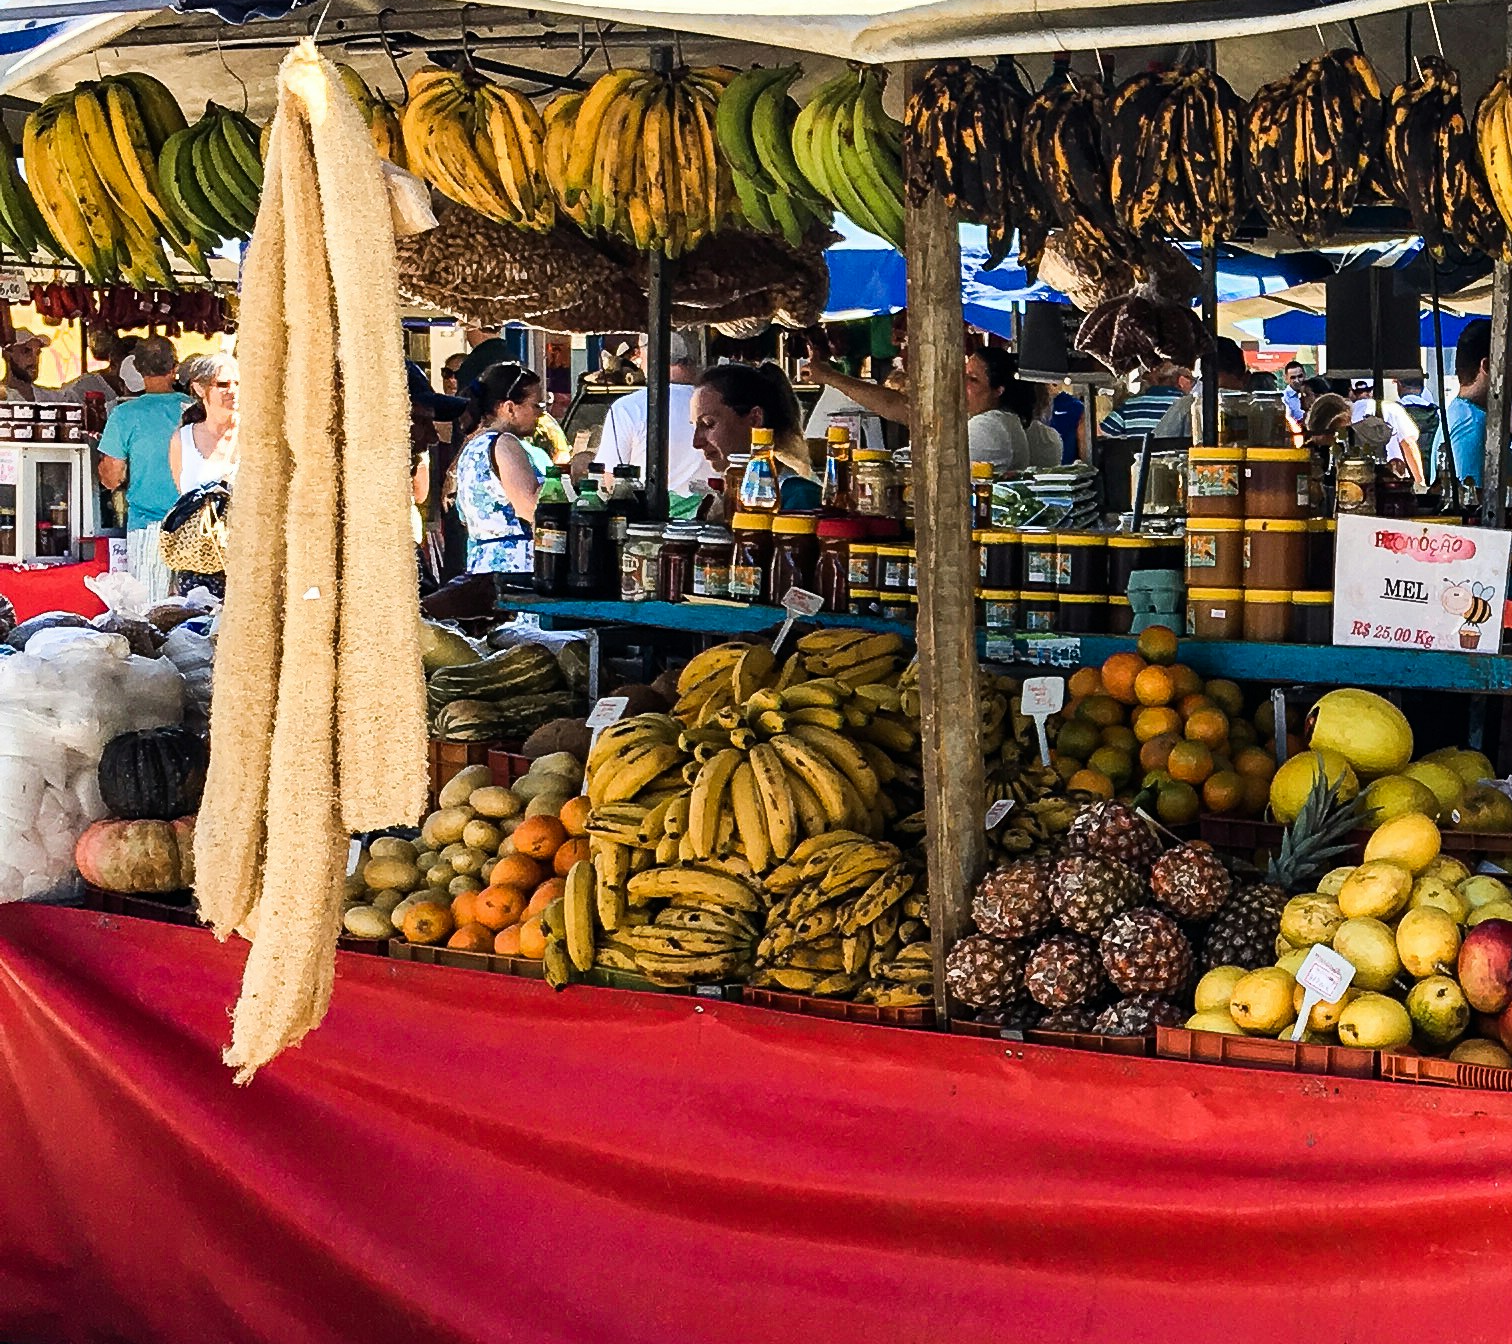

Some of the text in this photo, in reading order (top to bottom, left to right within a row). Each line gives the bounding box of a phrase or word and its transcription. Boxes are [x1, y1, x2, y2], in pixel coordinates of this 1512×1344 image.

[1384, 577, 1429, 601] MEL
[1350, 621, 1436, 649] R$ 25,00 Kg
